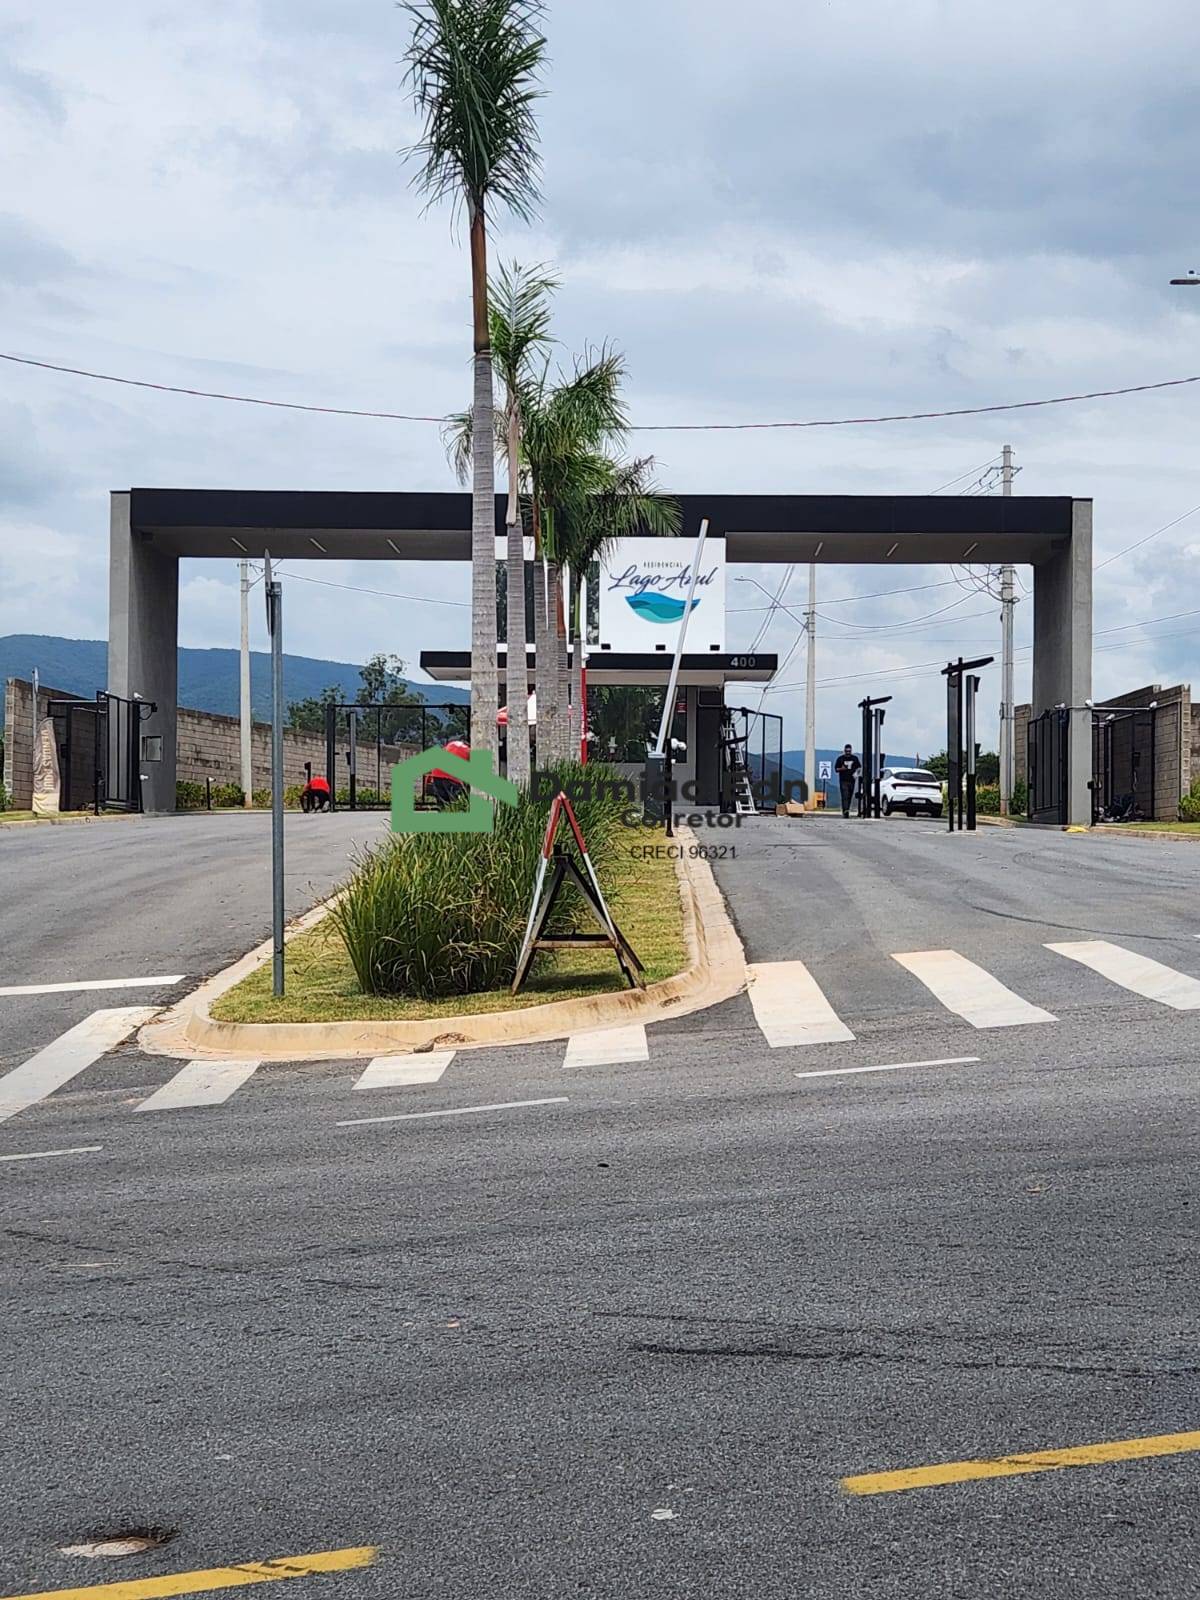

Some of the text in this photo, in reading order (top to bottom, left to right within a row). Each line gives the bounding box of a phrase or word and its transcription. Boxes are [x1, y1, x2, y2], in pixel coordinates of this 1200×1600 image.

[608, 564, 718, 596] Lago Azul
[730, 656, 756, 667] 400
